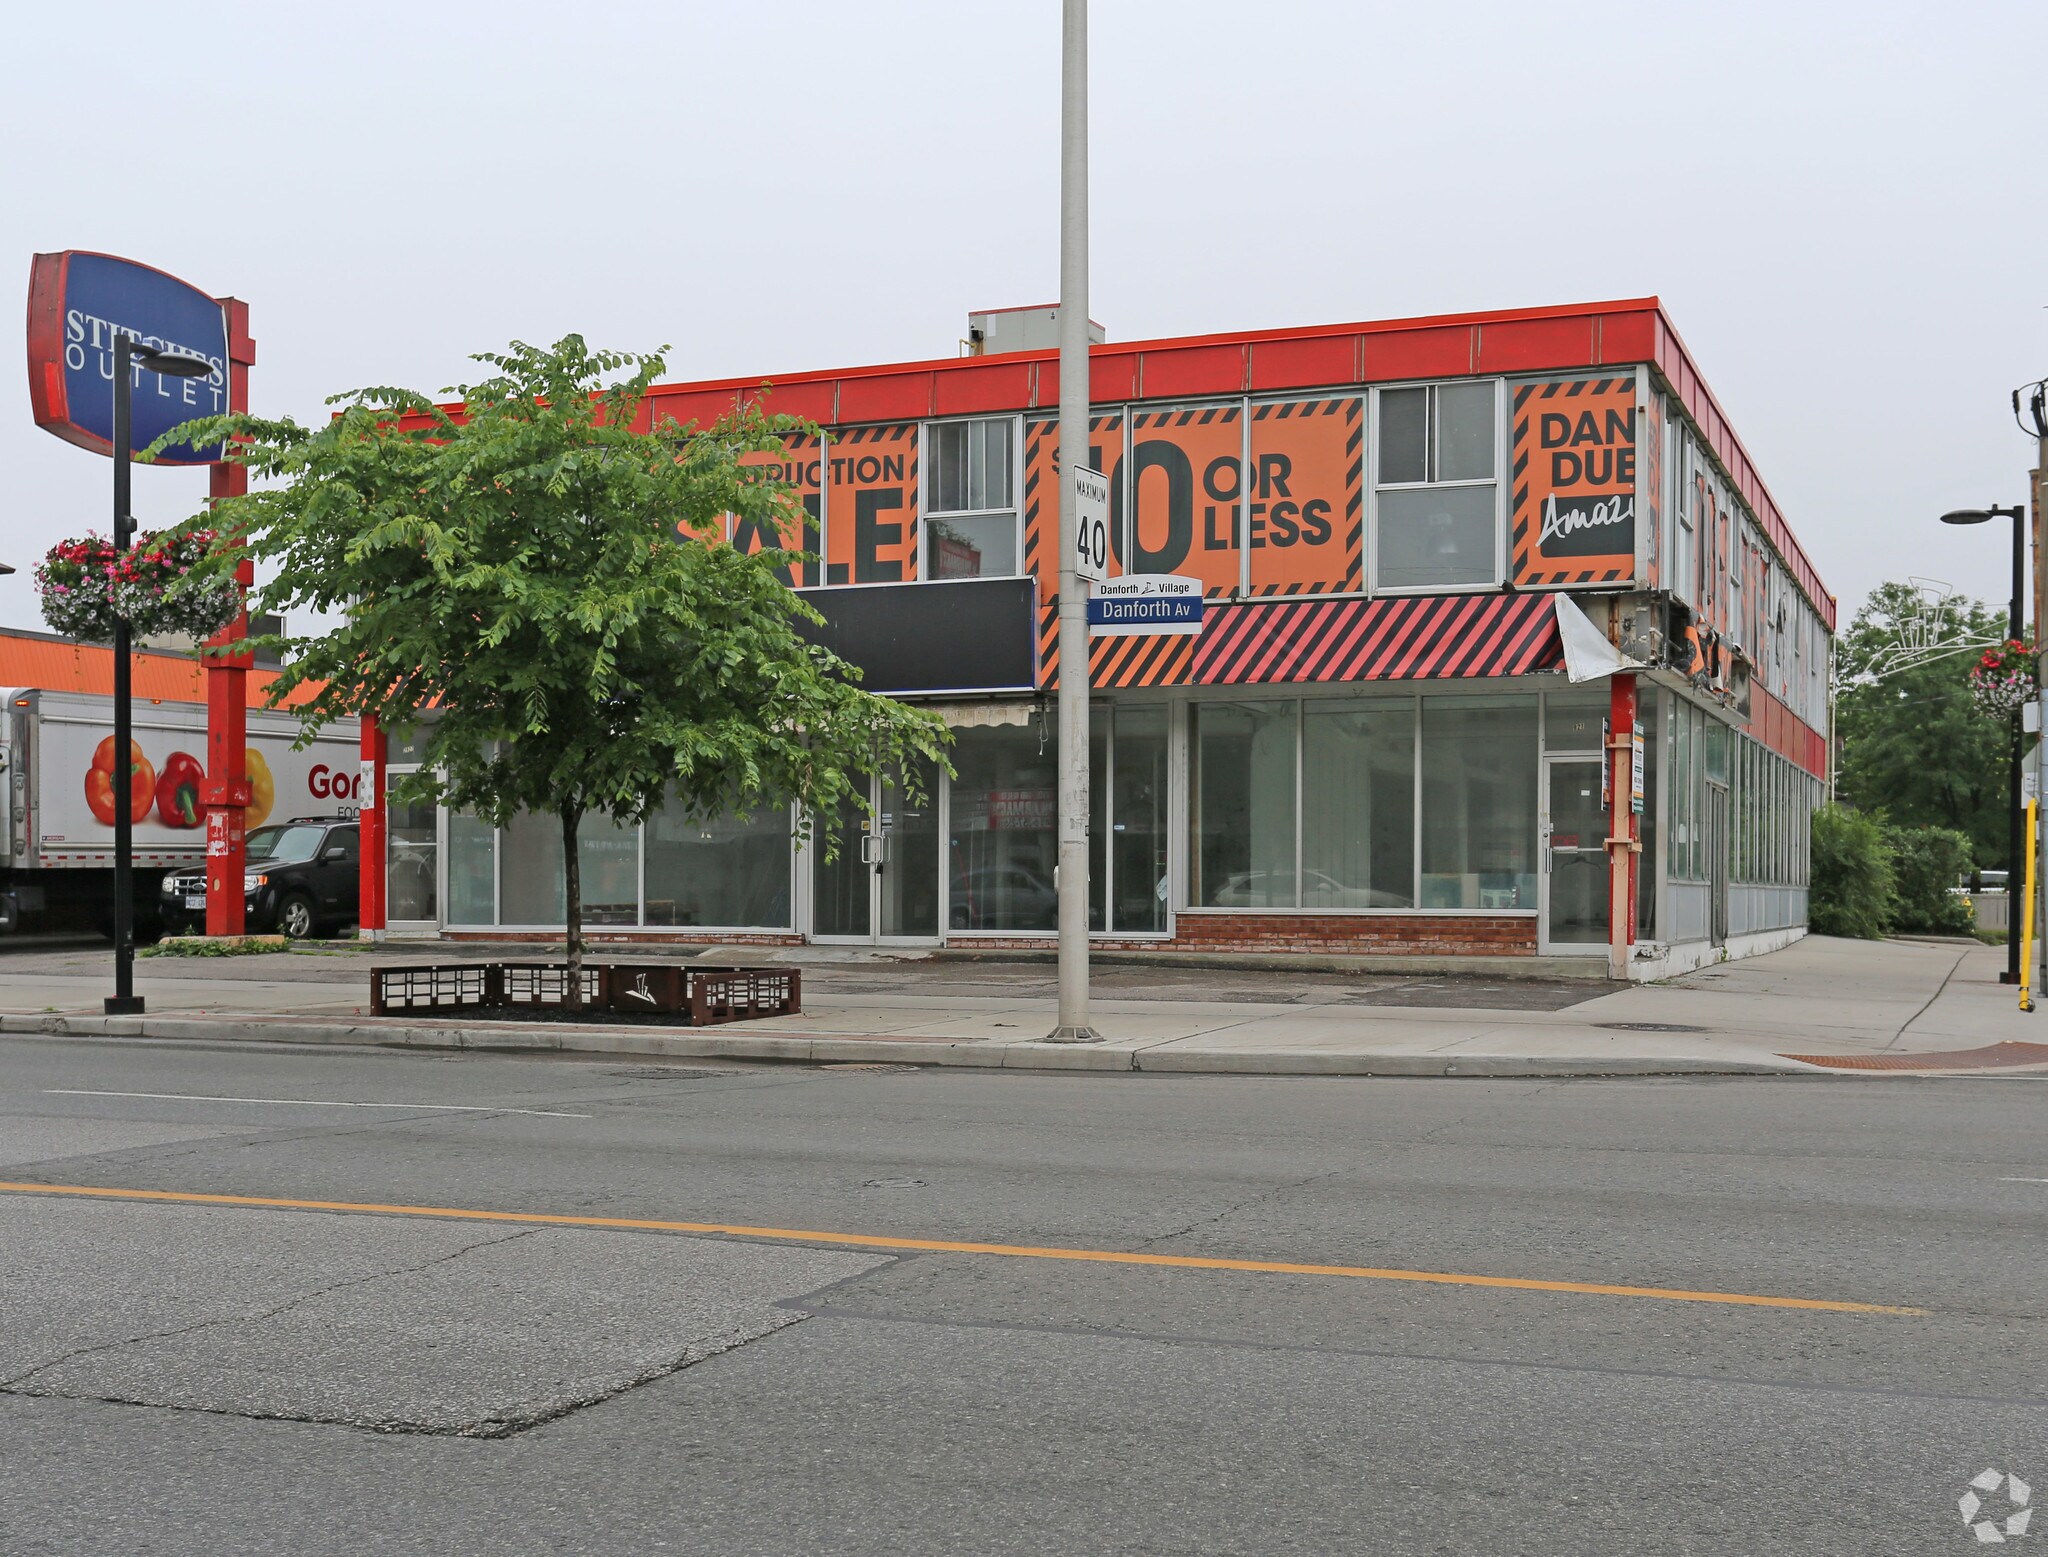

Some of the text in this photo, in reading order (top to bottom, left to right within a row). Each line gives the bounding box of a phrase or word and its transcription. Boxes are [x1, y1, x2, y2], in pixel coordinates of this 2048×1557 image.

[65, 343, 223, 412] OUTLET
[1541, 408, 1635, 449] DAN
[1203, 454, 1292, 503] OR
[1552, 448, 1635, 487] DUE
[1076, 479, 1106, 505] MAXIMUM
[668, 488, 903, 588] ALE
[1077, 515, 1106, 570] 40
[1204, 499, 1332, 551] LESS
[1100, 582, 1190, 595] Danforth Village
[1103, 600, 1191, 619] Danforth Av
